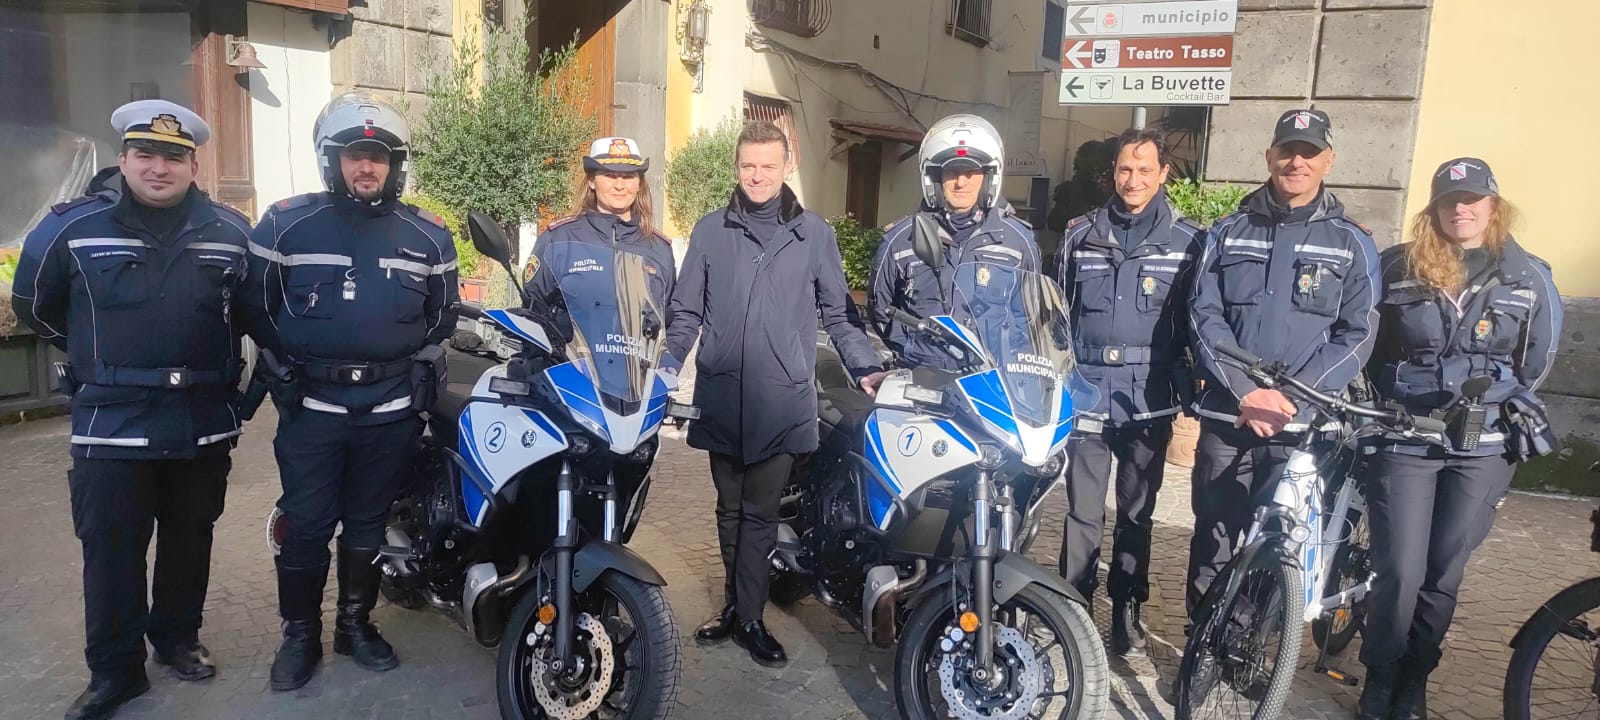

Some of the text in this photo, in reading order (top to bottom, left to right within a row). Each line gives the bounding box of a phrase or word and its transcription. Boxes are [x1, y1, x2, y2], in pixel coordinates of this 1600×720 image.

[1142, 10, 1229, 25] municipio
[1126, 45, 1226, 60] Teatro Tasso
[1122, 75, 1226, 91] La Buvette
[1166, 92, 1225, 102] Cocktail Bar
[573, 258, 597, 267] POLIZIA
[606, 333, 643, 347] POLIZIA
[595, 343, 653, 361] MUNICIPALE
[1017, 352, 1054, 368] POLIZIA
[1006, 363, 1063, 380] MUNICIPALE
[488, 426, 502, 448] 2
[905, 431, 915, 451] 1
